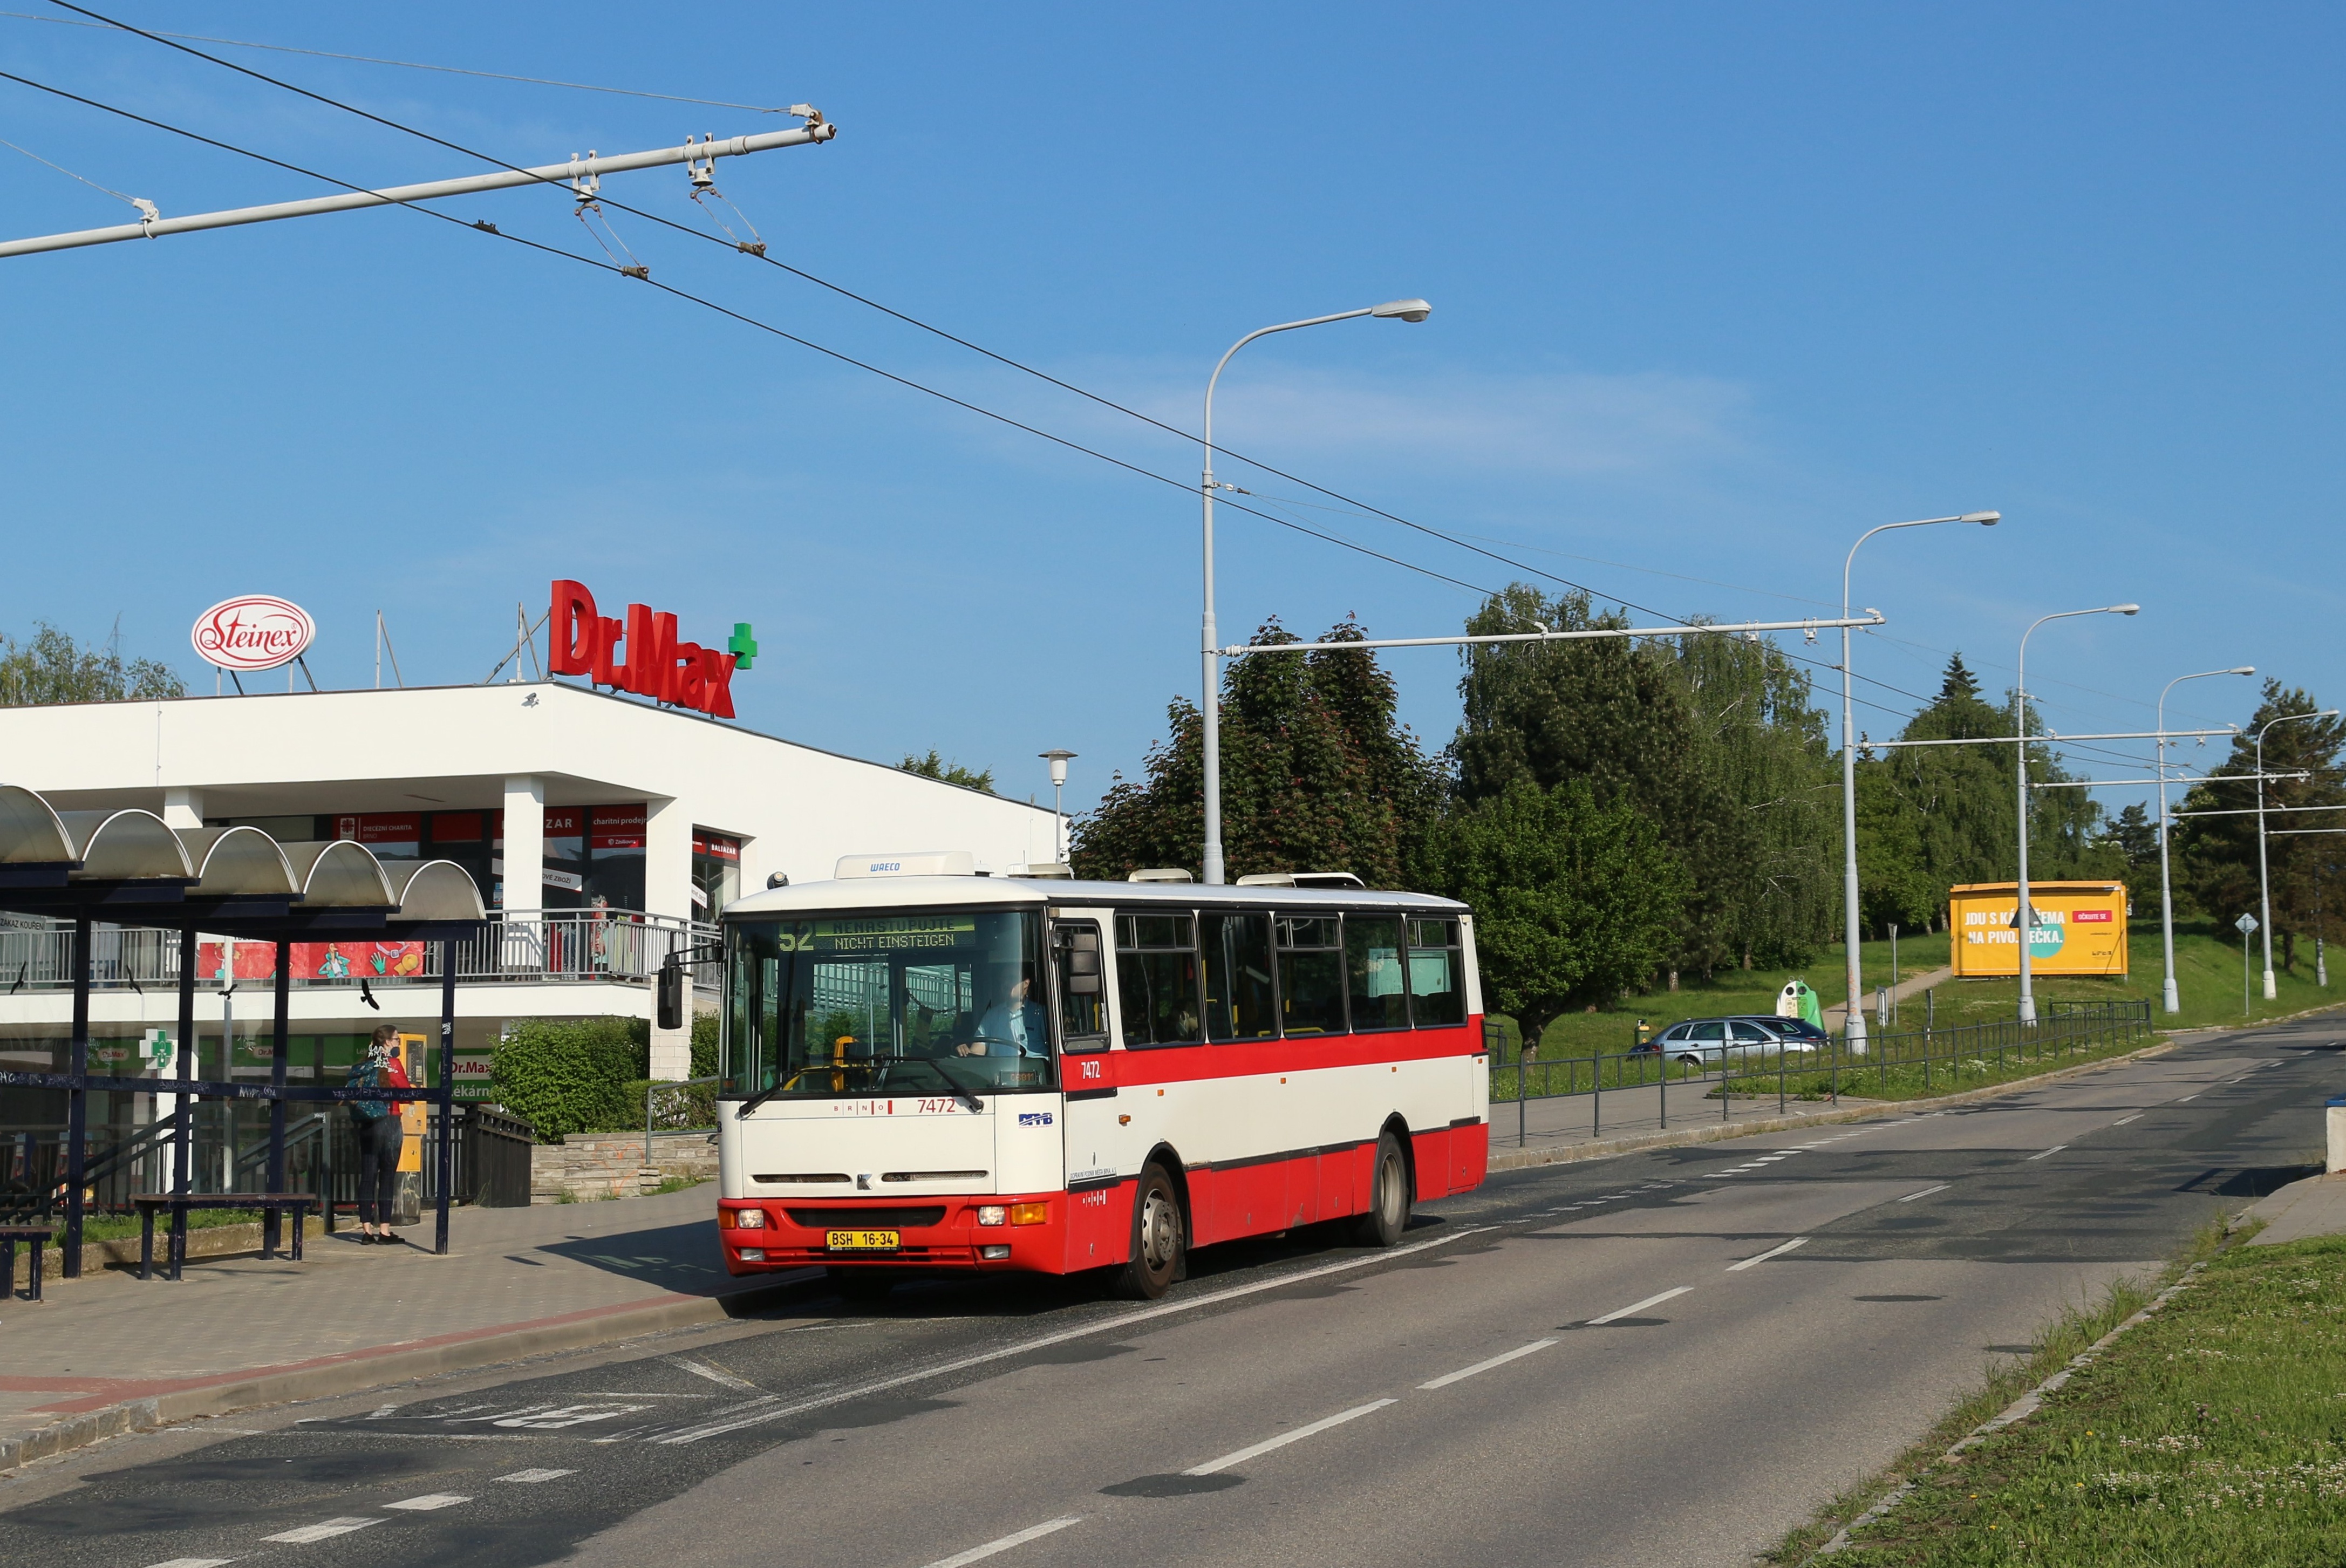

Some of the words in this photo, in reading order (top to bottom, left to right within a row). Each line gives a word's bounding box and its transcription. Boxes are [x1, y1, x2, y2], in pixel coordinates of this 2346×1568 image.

[200, 603, 297, 662] Steinex
[550, 580, 737, 719] Dr.Max
[594, 816, 619, 824] charitní
[870, 863, 900, 871] WAECO
[542, 872, 553, 881] OVÉ
[1, 917, 19, 928] ZÁKAZ
[20, 920, 45, 930] KOUŘENÍ
[1965, 912, 1986, 925] JDU
[1989, 912, 1997, 925] S
[779, 921, 814, 951] 52
[834, 919, 954, 934] NENASTUPUJTE
[1969, 931, 1984, 944] NA
[1988, 931, 2019, 944] PIVO.
[2029, 928, 2063, 944] EČKA.
[835, 937, 874, 950] NICHT
[879, 934, 954, 949] EINSTEIGEN
[1081, 1061, 1101, 1079] 7472
[451, 1084, 489, 1097] ékárn
[917, 1099, 956, 1113] 7472
[833, 1233, 853, 1245] BSH
[862, 1233, 894, 1245] 16-34
